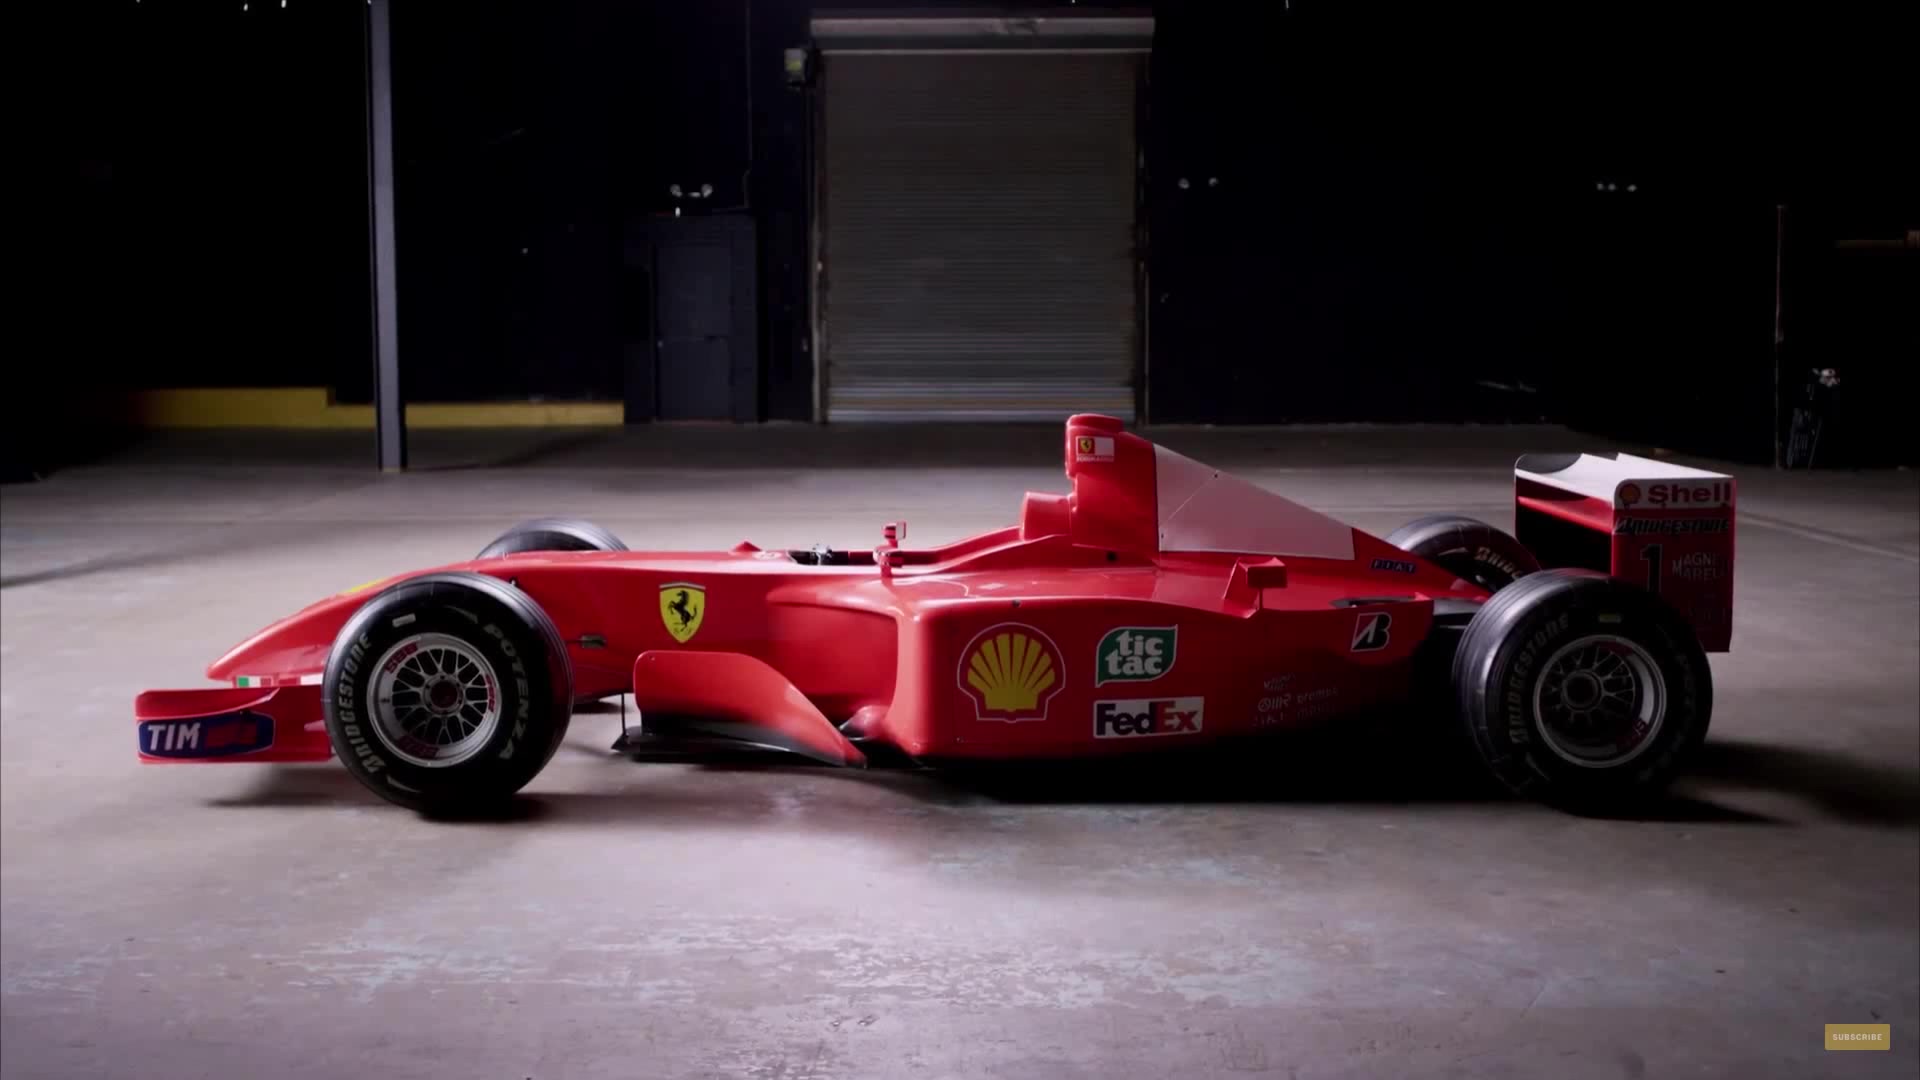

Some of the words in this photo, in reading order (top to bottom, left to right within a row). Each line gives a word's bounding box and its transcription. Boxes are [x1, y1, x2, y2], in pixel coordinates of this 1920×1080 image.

[1648, 483, 1730, 503] Shell
[1115, 630, 1164, 656] tic
[1105, 649, 1163, 675] tac
[338, 632, 386, 774] BRIDGESTONE
[483, 623, 529, 760] POTENZA
[1096, 701, 1199, 736] FedEx
[147, 721, 201, 751] TIM
